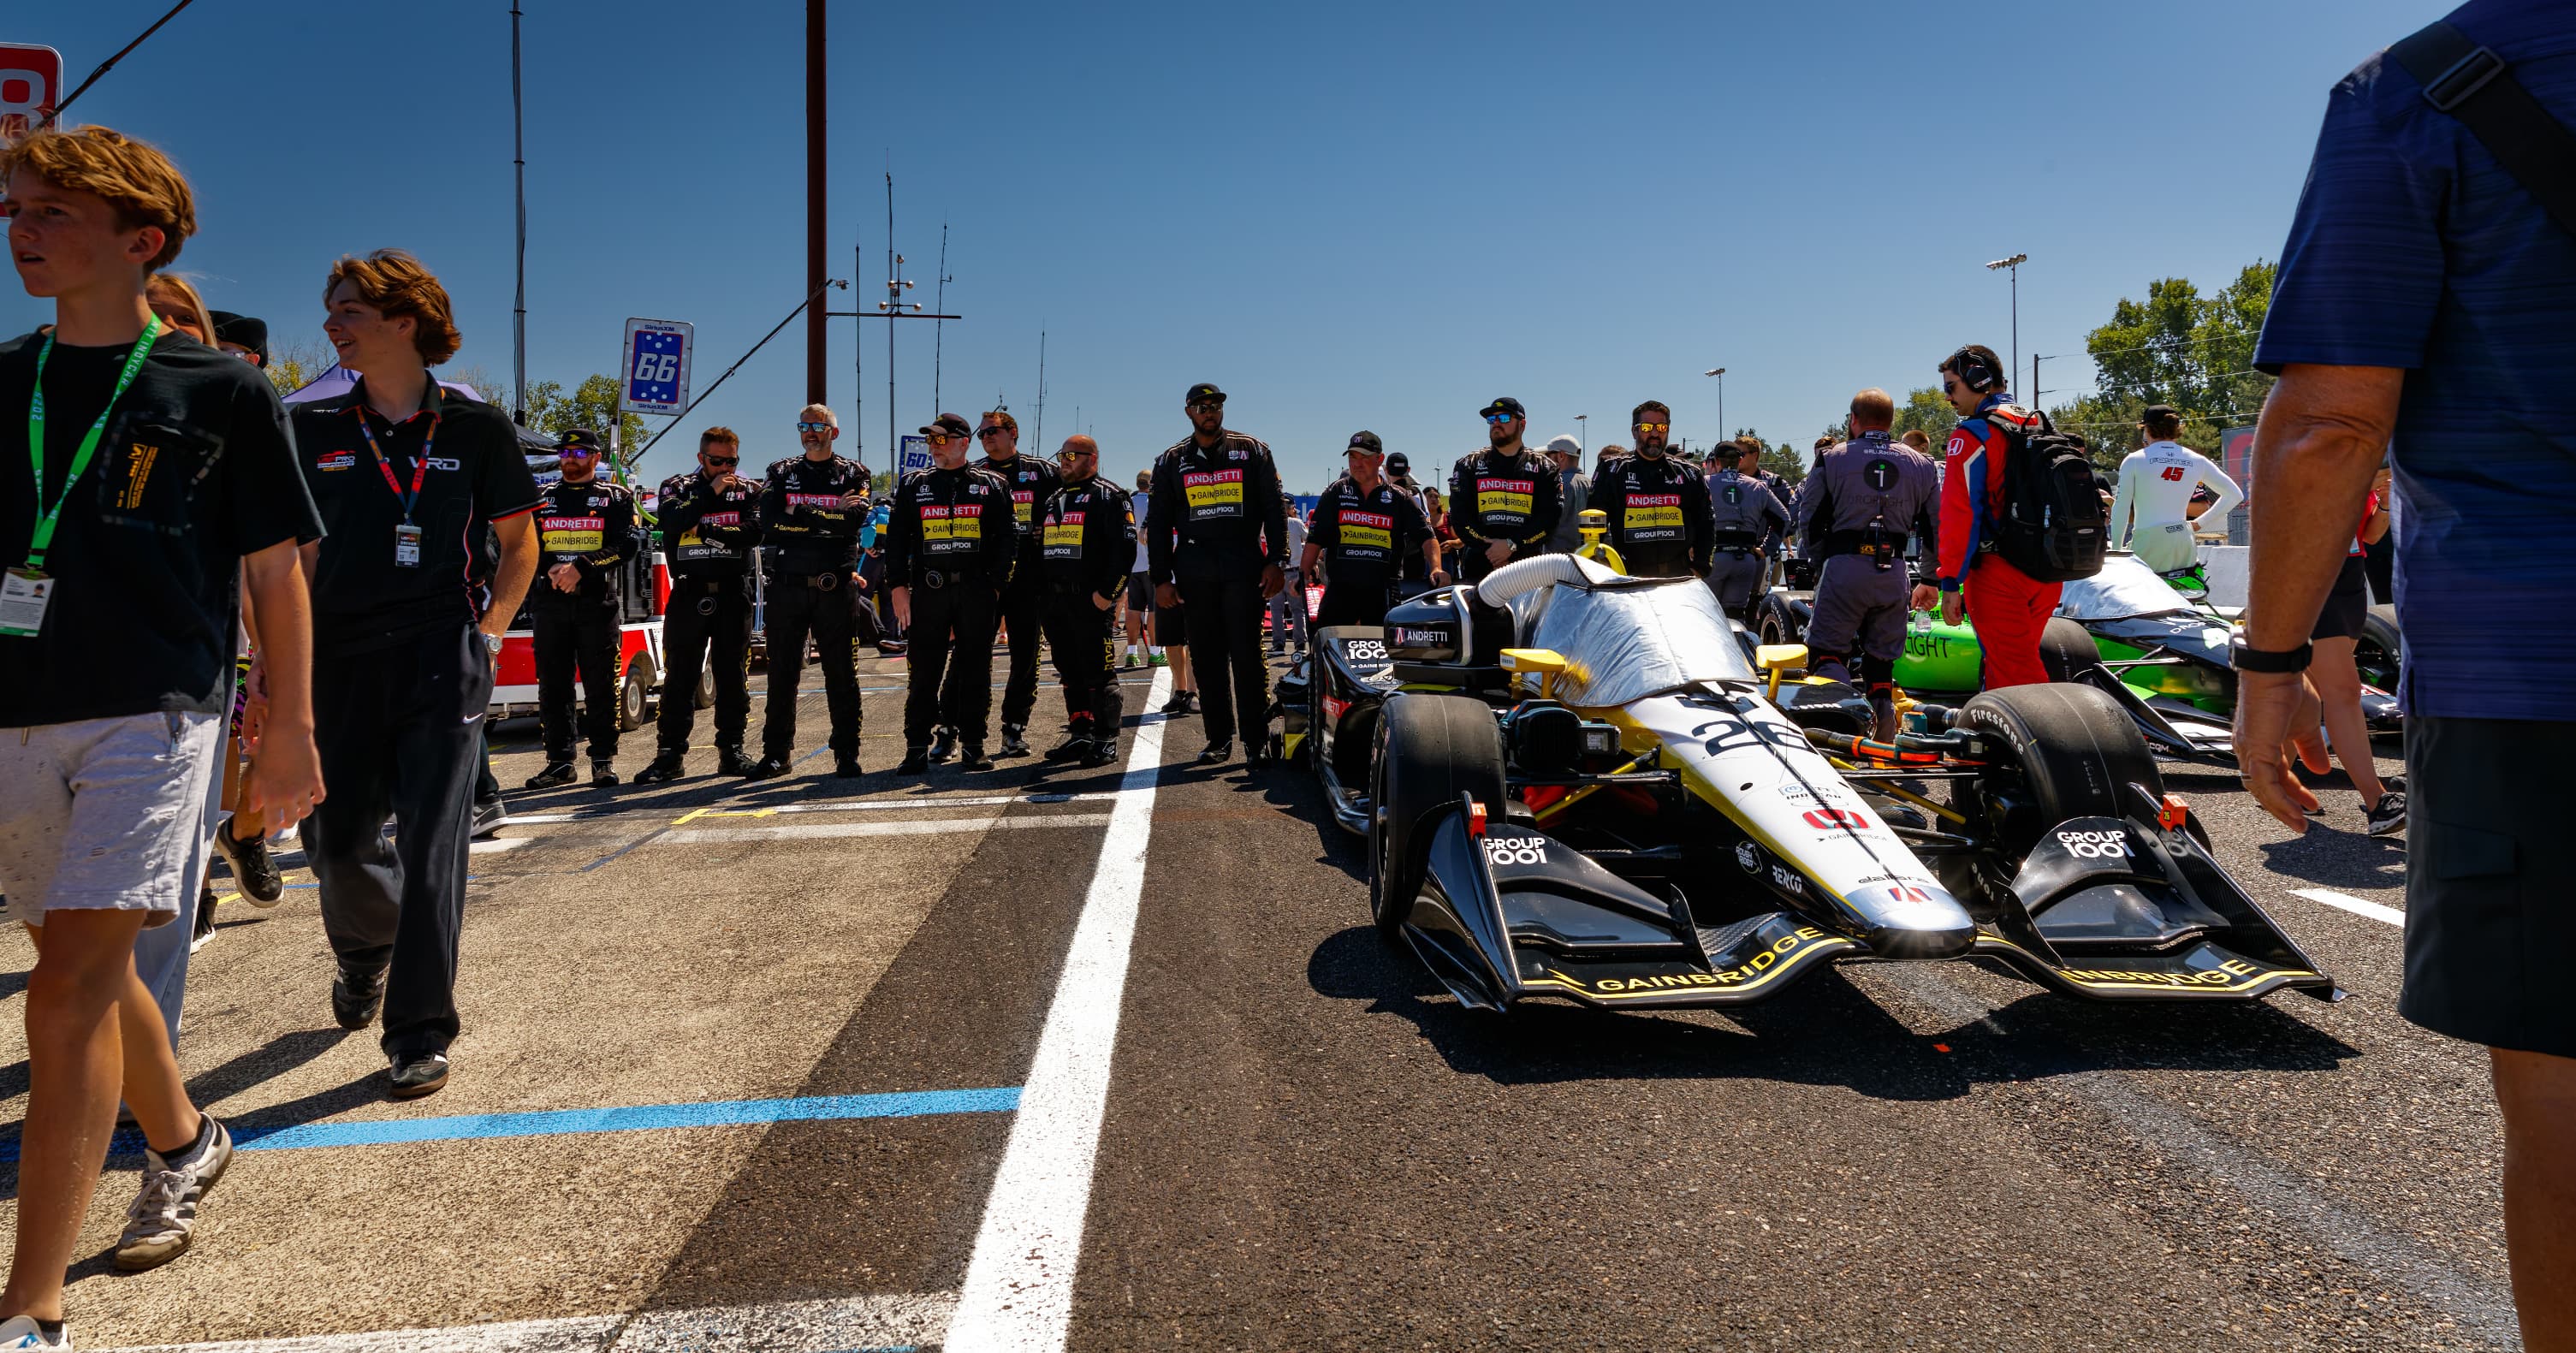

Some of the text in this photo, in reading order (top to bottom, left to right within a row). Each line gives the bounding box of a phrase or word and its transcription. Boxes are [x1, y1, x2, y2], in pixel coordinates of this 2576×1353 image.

[122, 341, 150, 385] INDYCAR
[634, 352, 679, 383] 66
[905, 452, 928, 468] 60
[1187, 471, 1240, 485] ANDRETTI
[2160, 466, 2185, 482] 45
[1479, 479, 1531, 491] ANDRETTI
[1197, 489, 1240, 500] GAINBRIDGE
[1627, 496, 1679, 506] ANDRETTI
[789, 496, 841, 507] ANDRETT
[1487, 495, 1530, 508] GAINBRIDGE
[923, 506, 981, 517] ANDRETTI
[1635, 513, 1679, 522] GAINBRIDGE
[545, 518, 602, 529] ANDRETTI
[702, 513, 738, 524] DRETTI
[1342, 513, 1391, 526] ANDRETTI
[932, 524, 979, 535] GAINBRIDGE
[551, 537, 599, 546] GAINBRIDGE
[1348, 531, 1388, 543] GAINBRIDGE
[1407, 631, 1448, 642] ANDRETTI
[1970, 707, 2024, 755] Firestone
[1691, 720, 1819, 757] 26
[1484, 837, 1546, 850] GROUP
[2057, 830, 2126, 845] GROUP
[1486, 848, 1548, 865] 1001
[2063, 842, 2136, 858] 1001
[1597, 926, 1825, 991] GAINBRIDGE
